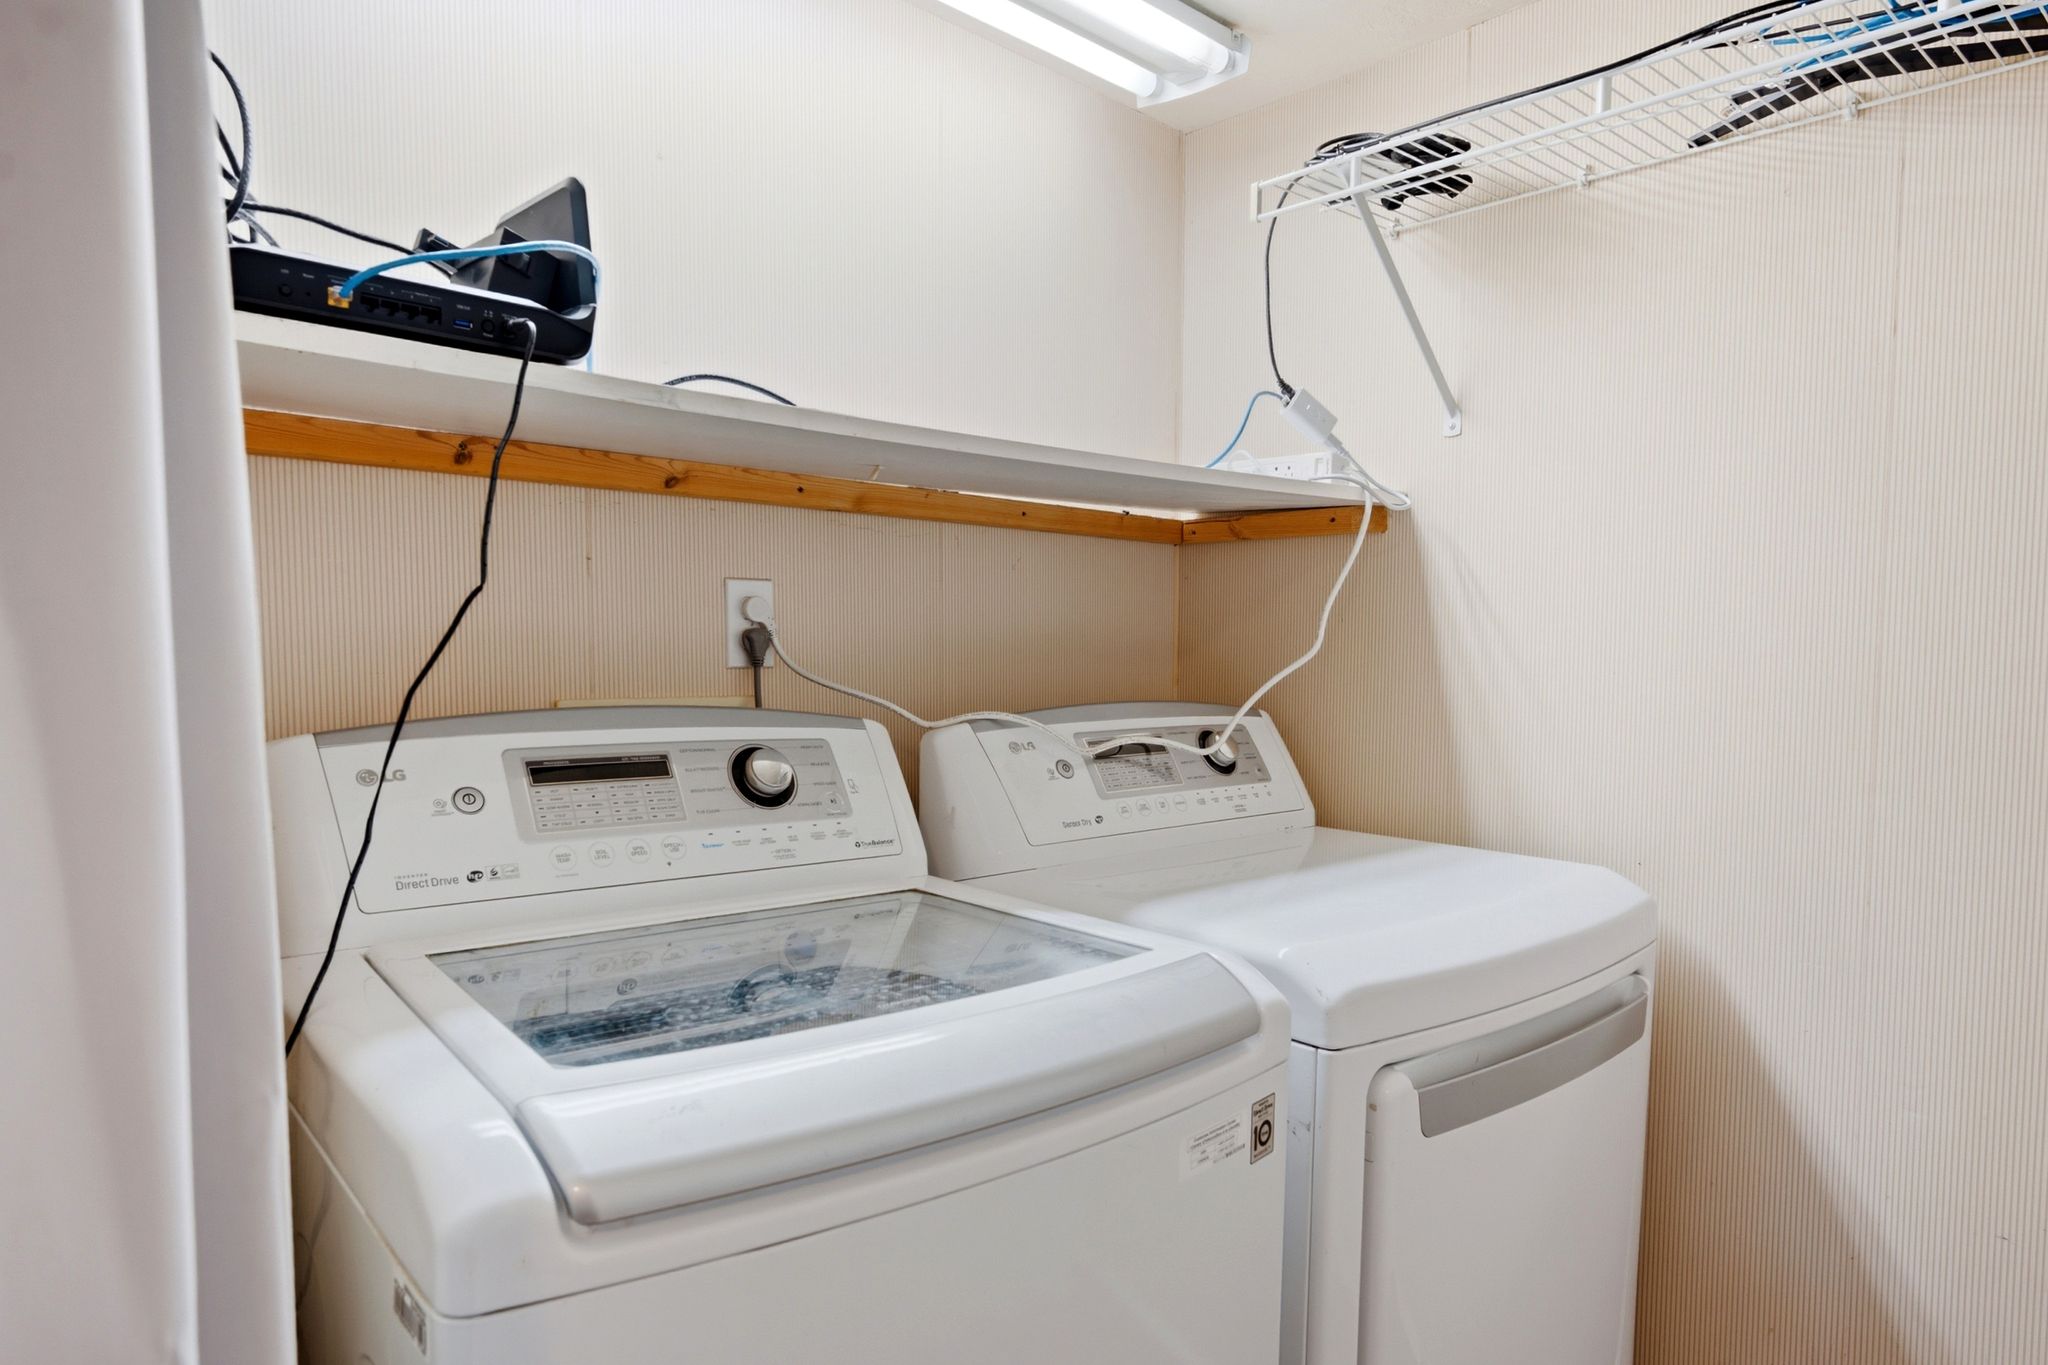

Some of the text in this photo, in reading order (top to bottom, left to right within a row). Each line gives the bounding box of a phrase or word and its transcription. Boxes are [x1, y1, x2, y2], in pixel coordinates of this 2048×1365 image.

[395, 879, 429, 891] Direct
[431, 876, 460, 888] Drive
[1254, 1120, 1272, 1152] 10
